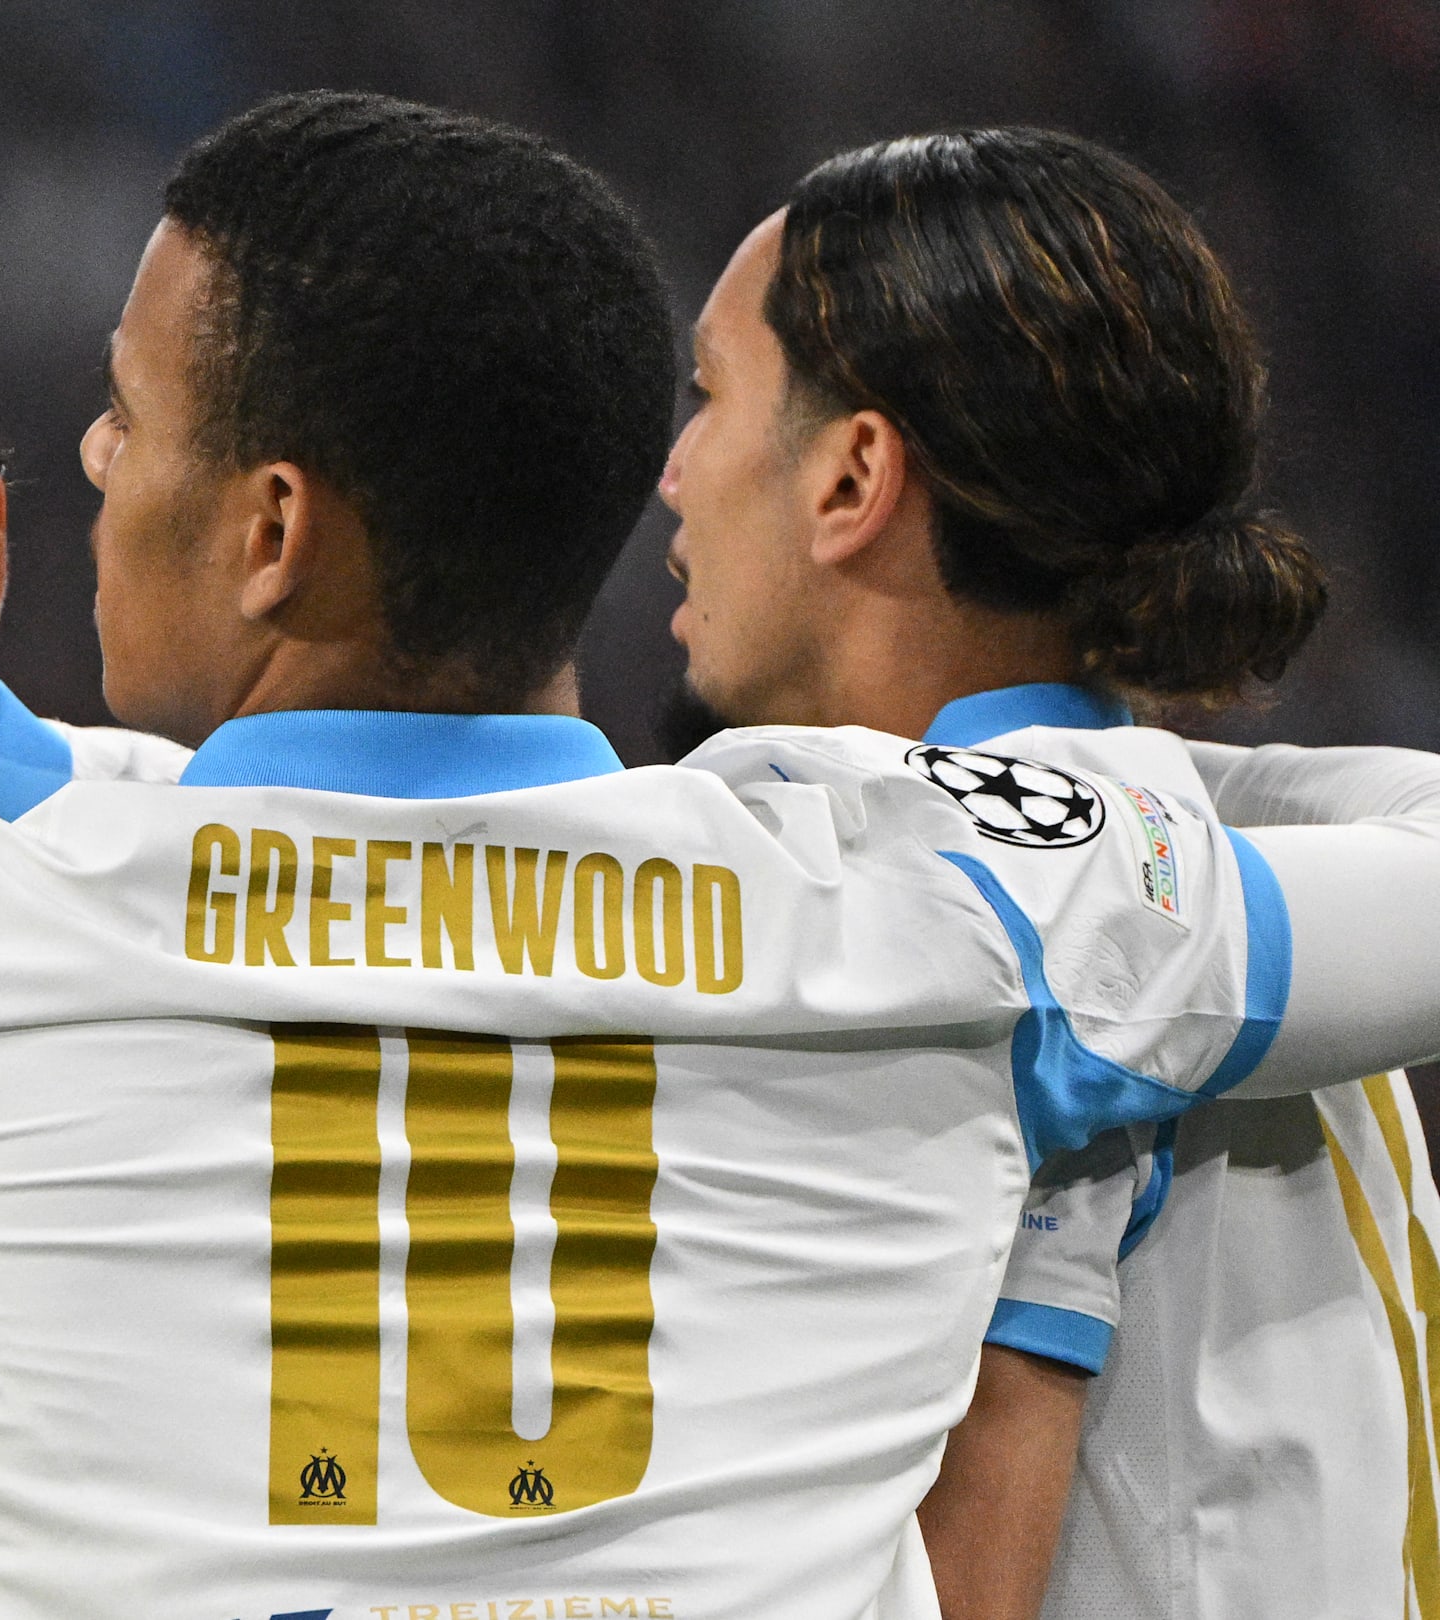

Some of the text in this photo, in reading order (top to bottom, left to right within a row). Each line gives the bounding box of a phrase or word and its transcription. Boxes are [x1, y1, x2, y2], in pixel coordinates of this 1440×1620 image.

[184, 822, 744, 995] GREENWOOD
[1119, 782, 1175, 912] FOUNDATIO
[1142, 860, 1155, 903] UEFA
[268, 1020, 659, 1526] 10
